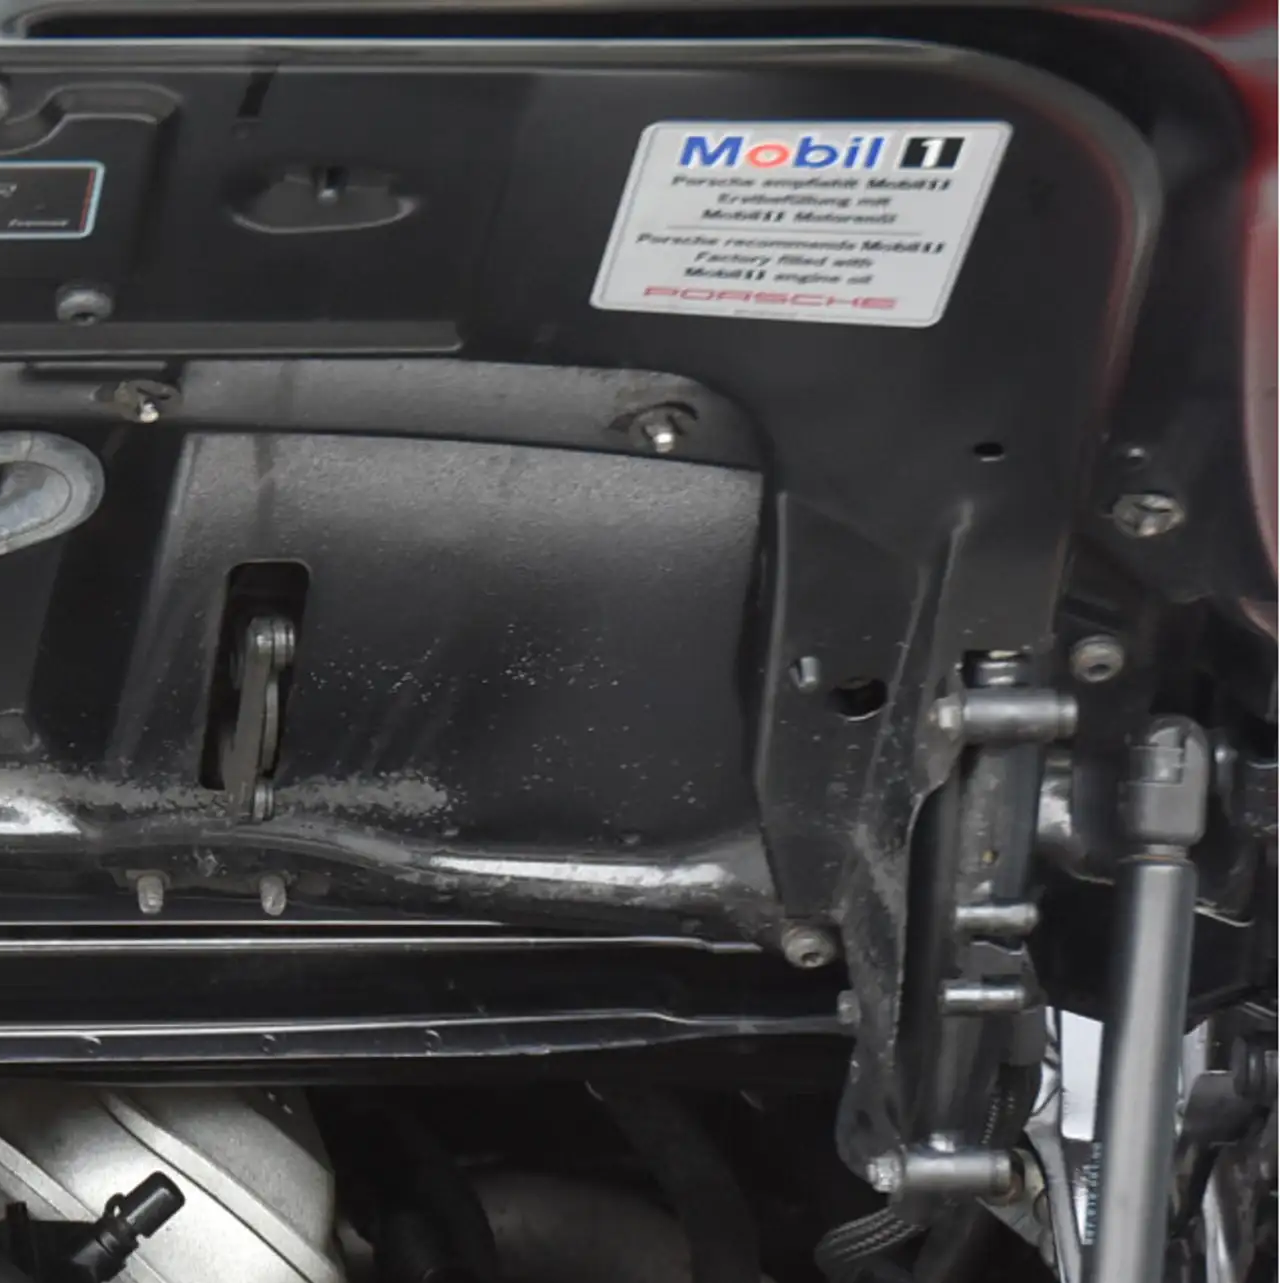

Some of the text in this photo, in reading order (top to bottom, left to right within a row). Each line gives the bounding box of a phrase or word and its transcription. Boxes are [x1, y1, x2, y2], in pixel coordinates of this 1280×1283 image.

[679, 136, 885, 168] Mobil
[671, 175, 755, 188] Porsche
[635, 232, 720, 245] Porsche
[693, 250, 772, 267] Factory
[773, 271, 841, 285] engine
[643, 285, 899, 310] PORSCHE
